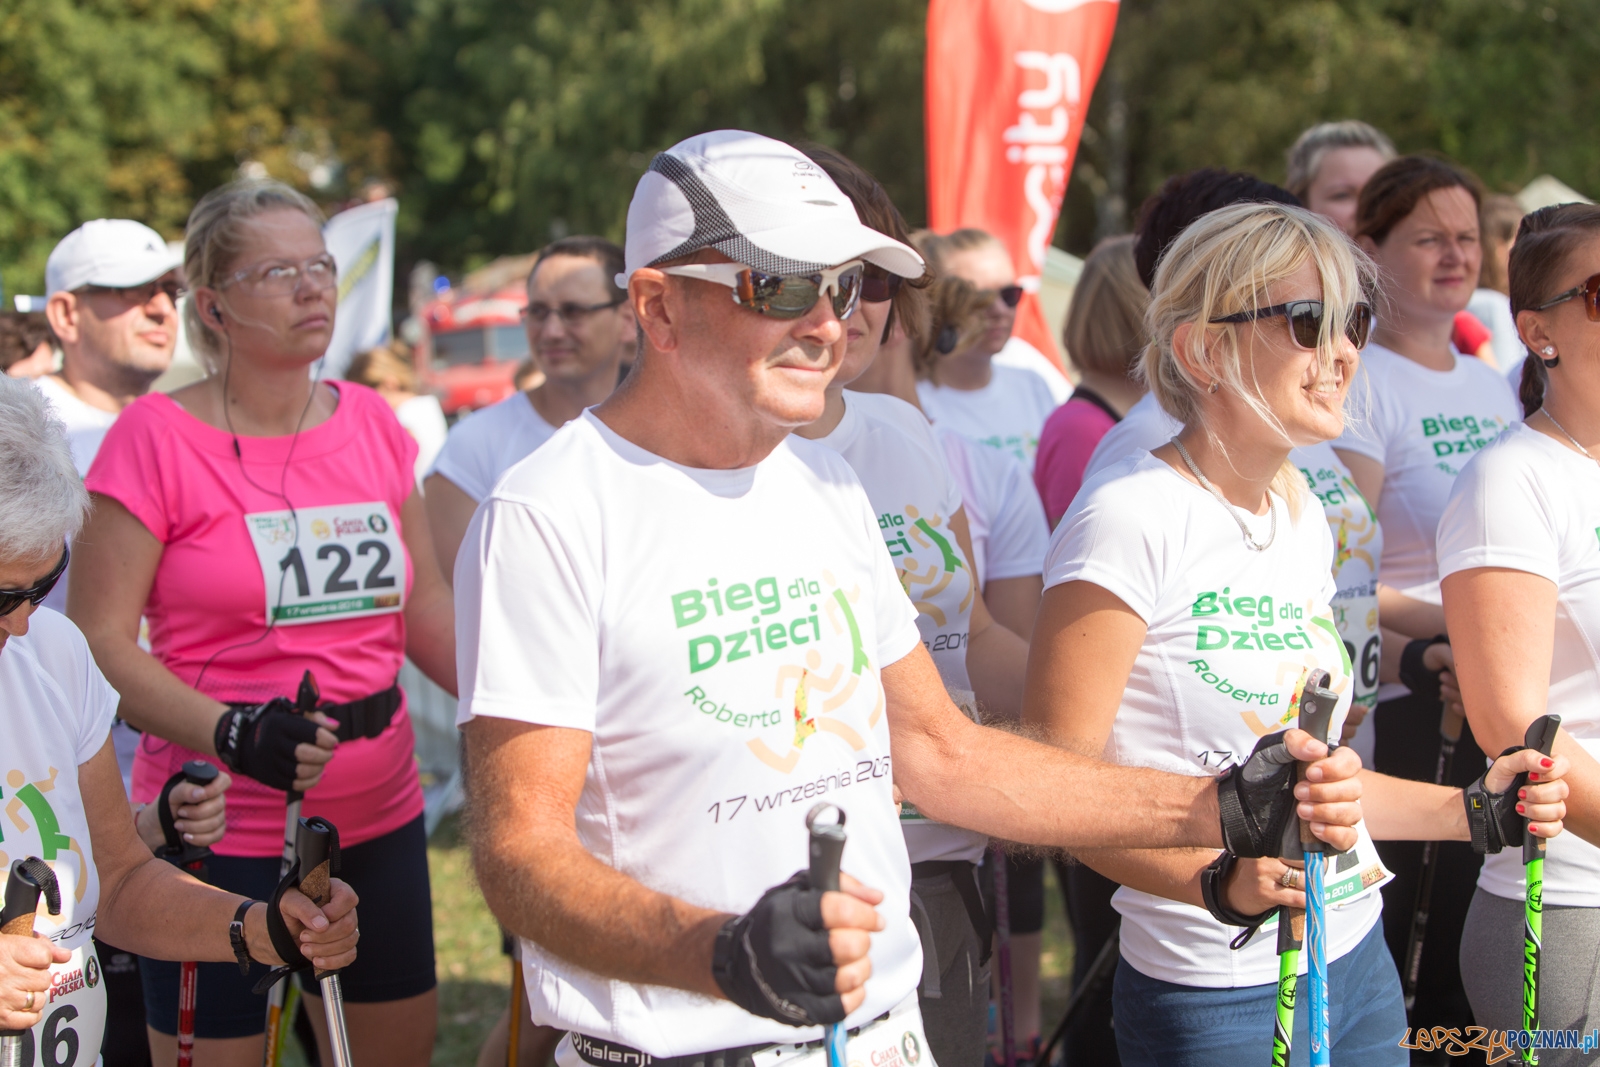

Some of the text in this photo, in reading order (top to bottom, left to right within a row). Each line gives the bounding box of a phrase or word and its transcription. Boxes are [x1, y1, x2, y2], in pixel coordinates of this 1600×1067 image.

[1422, 413, 1480, 436] Bieg
[279, 540, 395, 597] 122
[671, 577, 821, 628] Bieg dla
[1192, 587, 1303, 627] Bieg dla
[688, 603, 821, 674] Dzieci
[1196, 623, 1313, 651] Dzieci
[1188, 659, 1279, 706] Roberta
[684, 685, 781, 728] Roberta
[1197, 750, 1232, 768] 17
[707, 795, 747, 823] 17
[754, 767, 851, 812] września
[1332, 882, 1355, 897] 2016
[49, 979, 85, 1003] POLSKA
[51, 968, 83, 987] CHATA
[871, 1045, 899, 1066] CHATA
